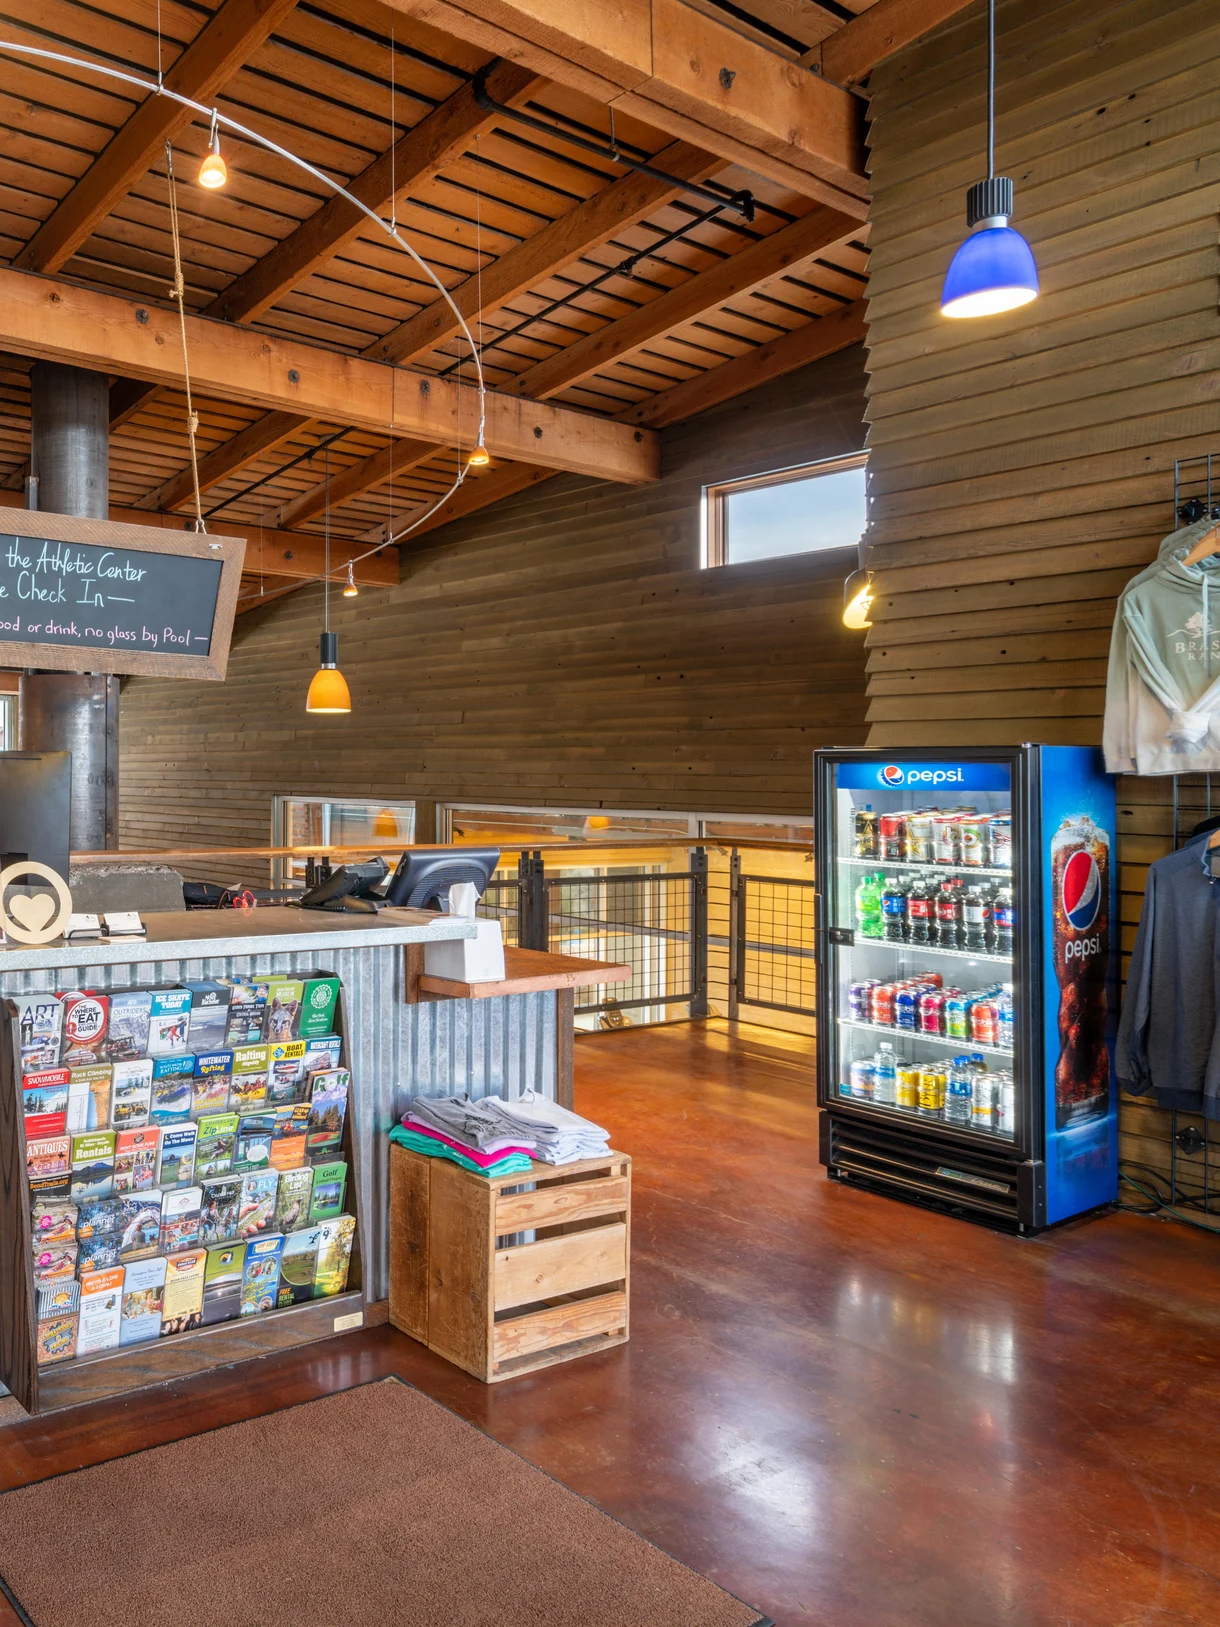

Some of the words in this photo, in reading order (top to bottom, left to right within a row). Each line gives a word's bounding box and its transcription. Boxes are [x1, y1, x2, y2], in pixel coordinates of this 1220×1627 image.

[5, 537, 32, 568] the
[36, 541, 94, 576] Athletic
[97, 552, 147, 581] Center
[17, 571, 67, 603] Check
[76, 578, 105, 608] In
[27, 623, 42, 633] or
[45, 619, 81, 638] drink,
[85, 627, 104, 638] no
[107, 625, 137, 645] glass
[142, 626, 158, 648] by
[163, 627, 191, 646] Pool
[907, 768, 963, 785] pepsi
[1065, 933, 1100, 964] pepsi
[155, 994, 167, 1003] ICE
[168, 993, 190, 1002] SKATE
[161, 1001, 184, 1009] TODAY
[20, 1003, 60, 1026] ART
[78, 1012, 101, 1023] EAT
[78, 1024, 97, 1032] GUIDE
[286, 1043, 303, 1052] BOAT
[235, 1050, 267, 1062] Rafting
[284, 1050, 304, 1058] RENTALS
[198, 1055, 231, 1066] WHITEWATER
[87, 1068, 112, 1077] Climbing
[201, 1064, 225, 1074] Rafting
[27, 1074, 65, 1085] SNOWMOBILE
[27, 1141, 68, 1156] ANTIQUES
[76, 1146, 112, 1159] Rentals
[285, 1173, 309, 1184] Birding
[323, 1169, 339, 1178] Golf
[258, 1180, 274, 1190] FLY
[289, 1181, 303, 1189] List
[83, 1214, 116, 1228] planner
[85, 1248, 118, 1263] planner
[279, 1287, 291, 1296] FREE
